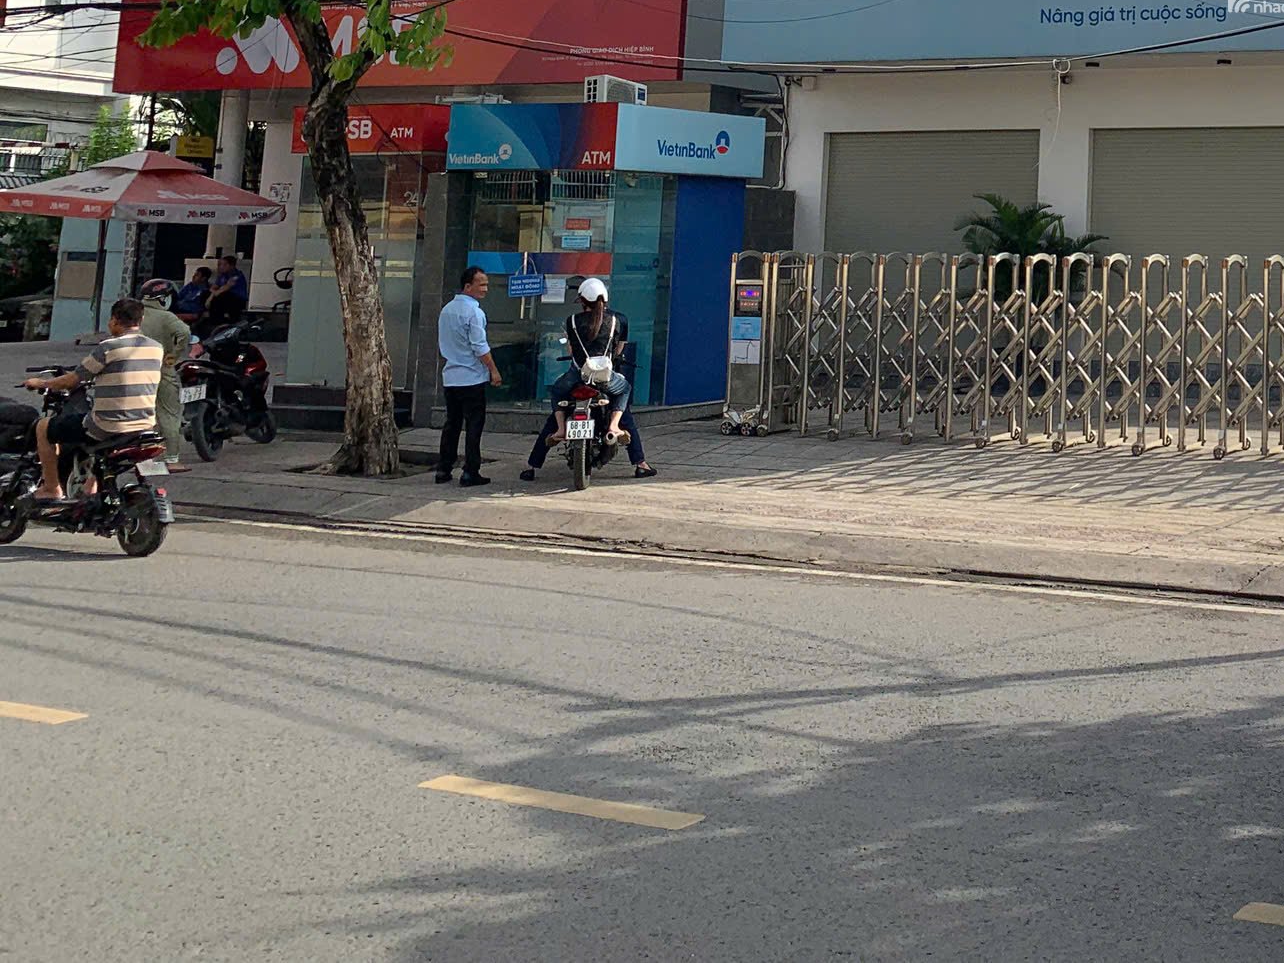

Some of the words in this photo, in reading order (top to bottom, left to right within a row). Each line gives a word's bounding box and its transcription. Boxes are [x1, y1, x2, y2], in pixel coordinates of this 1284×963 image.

[1040, 8, 1084, 27] Nâng
[1088, 6, 1115, 25] giá
[1119, 5, 1136, 24] trị
[1140, 4, 1181, 23] cuộc
[1185, 1, 1227, 21] sống
[345, 119, 372, 139] SB
[390, 127, 413, 138] ATM
[657, 139, 716, 159] VietinBank
[449, 153, 499, 164] VietinBank
[581, 151, 611, 164] ATM
[149, 209, 165, 217] MSB
